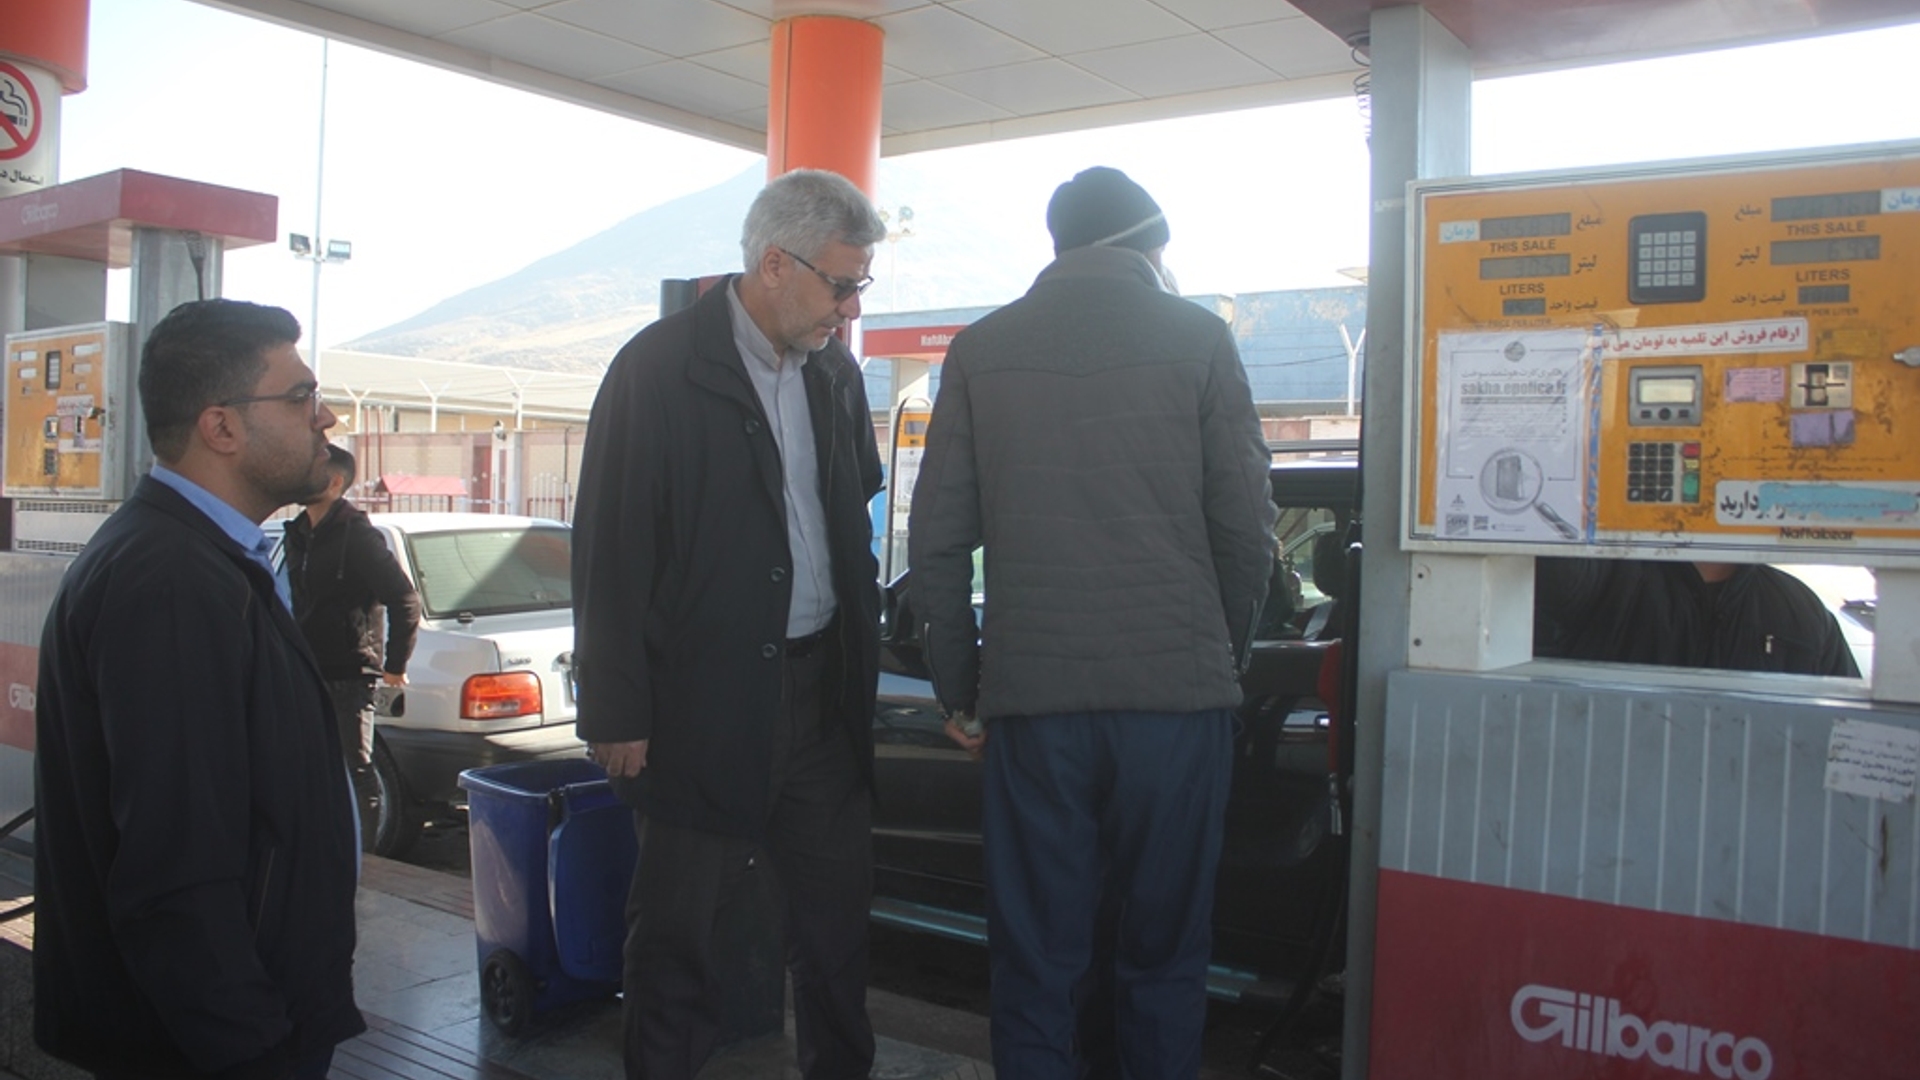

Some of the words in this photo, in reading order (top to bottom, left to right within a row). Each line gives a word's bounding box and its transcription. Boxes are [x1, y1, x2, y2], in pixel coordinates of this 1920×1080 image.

[1734, 204, 1763, 222] مبلغ
[1576, 213, 1602, 231] مبلغ
[1786, 223, 1820, 236] THIS
[1825, 220, 1867, 234] SALE
[1443, 223, 1476, 241] تومان
[1490, 241, 1518, 254] THIS
[1522, 239, 1557, 251] SALE
[1575, 254, 1597, 274] لیتر
[1735, 246, 1760, 266] لیتر
[1795, 268, 1850, 283] LITERS
[1500, 282, 1545, 296] LITERS
[1760, 289, 1787, 305] قیمت
[1550, 299, 1572, 312] واحد
[1574, 297, 1599, 311] قیمت
[1731, 292, 1758, 306] واحد
[1633, 334, 1664, 351] تومان
[1667, 336, 1677, 347] به
[1680, 332, 1707, 346] تلمبه
[1709, 332, 1729, 347] این
[1731, 328, 1767, 346] فروش
[1769, 326, 1800, 343] ارقام
[1613, 340, 1630, 352] می
[8, 682, 36, 711] Gilb
[1510, 984, 1773, 1080] Gilbarco
